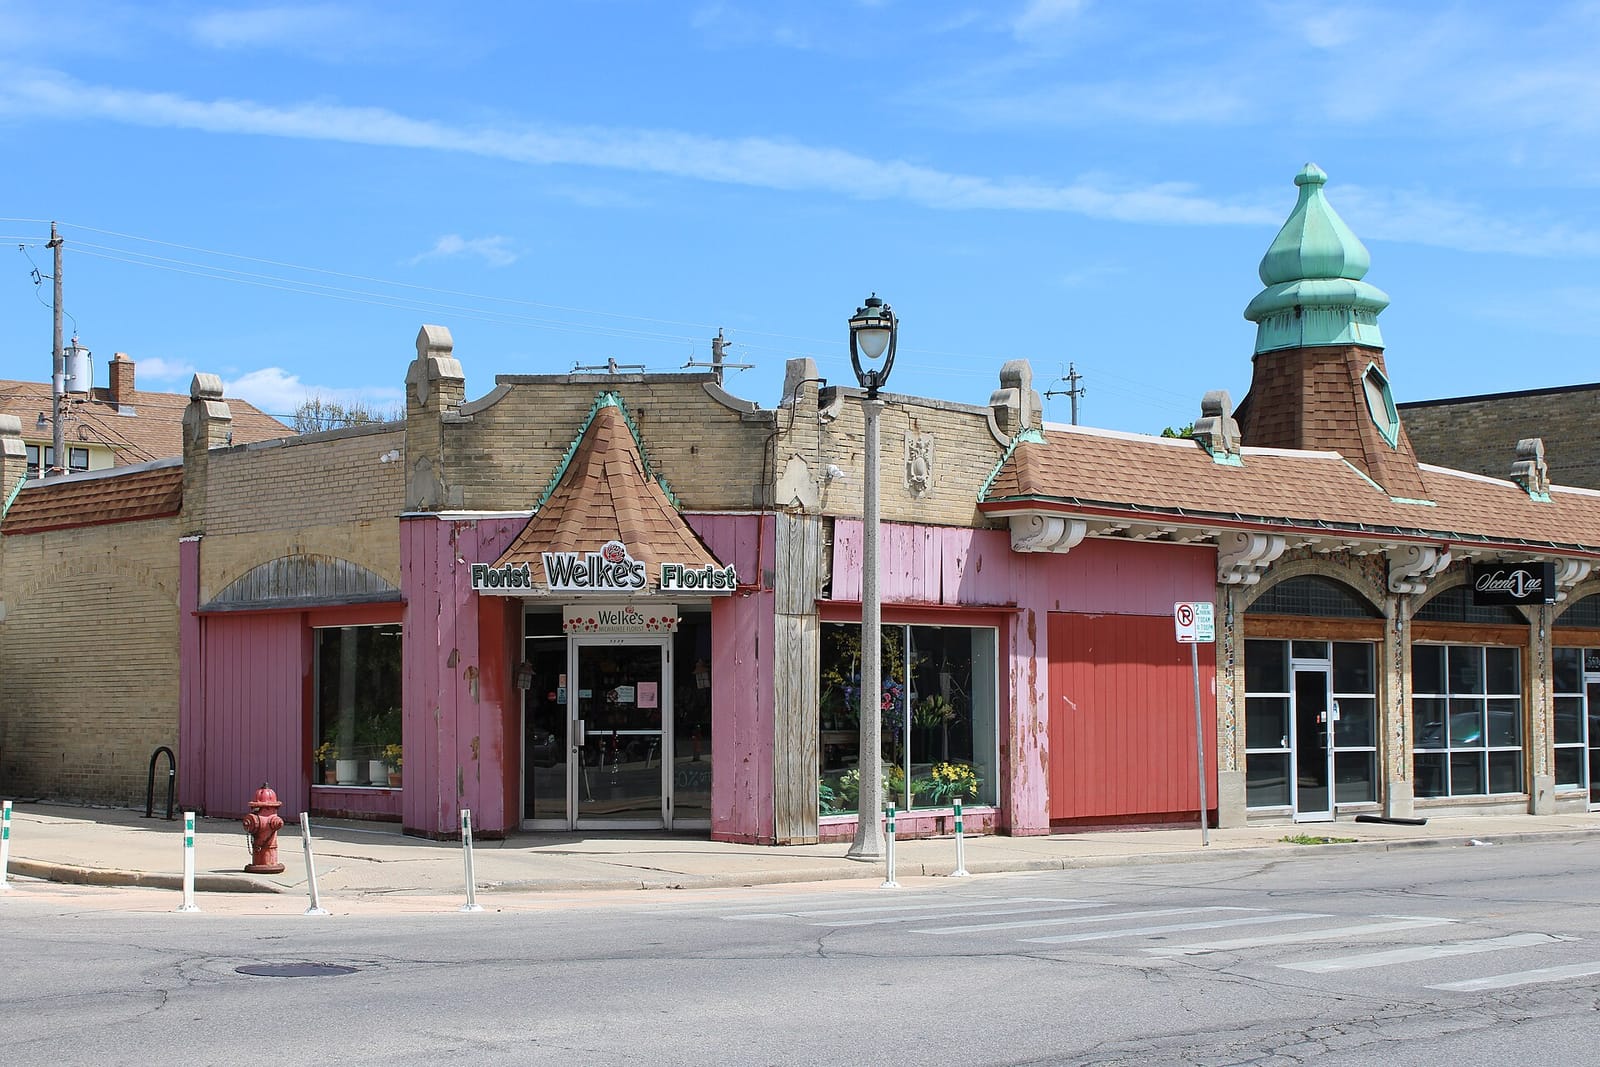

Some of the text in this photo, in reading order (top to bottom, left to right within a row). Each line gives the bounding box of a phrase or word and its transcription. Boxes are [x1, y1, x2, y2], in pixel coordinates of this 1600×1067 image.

[473, 564, 530, 588] Florist
[543, 554, 645, 588] Welke's
[662, 564, 735, 588] Florist
[1476, 570, 1516, 591] Scene
[598, 610, 644, 625] Welke's
